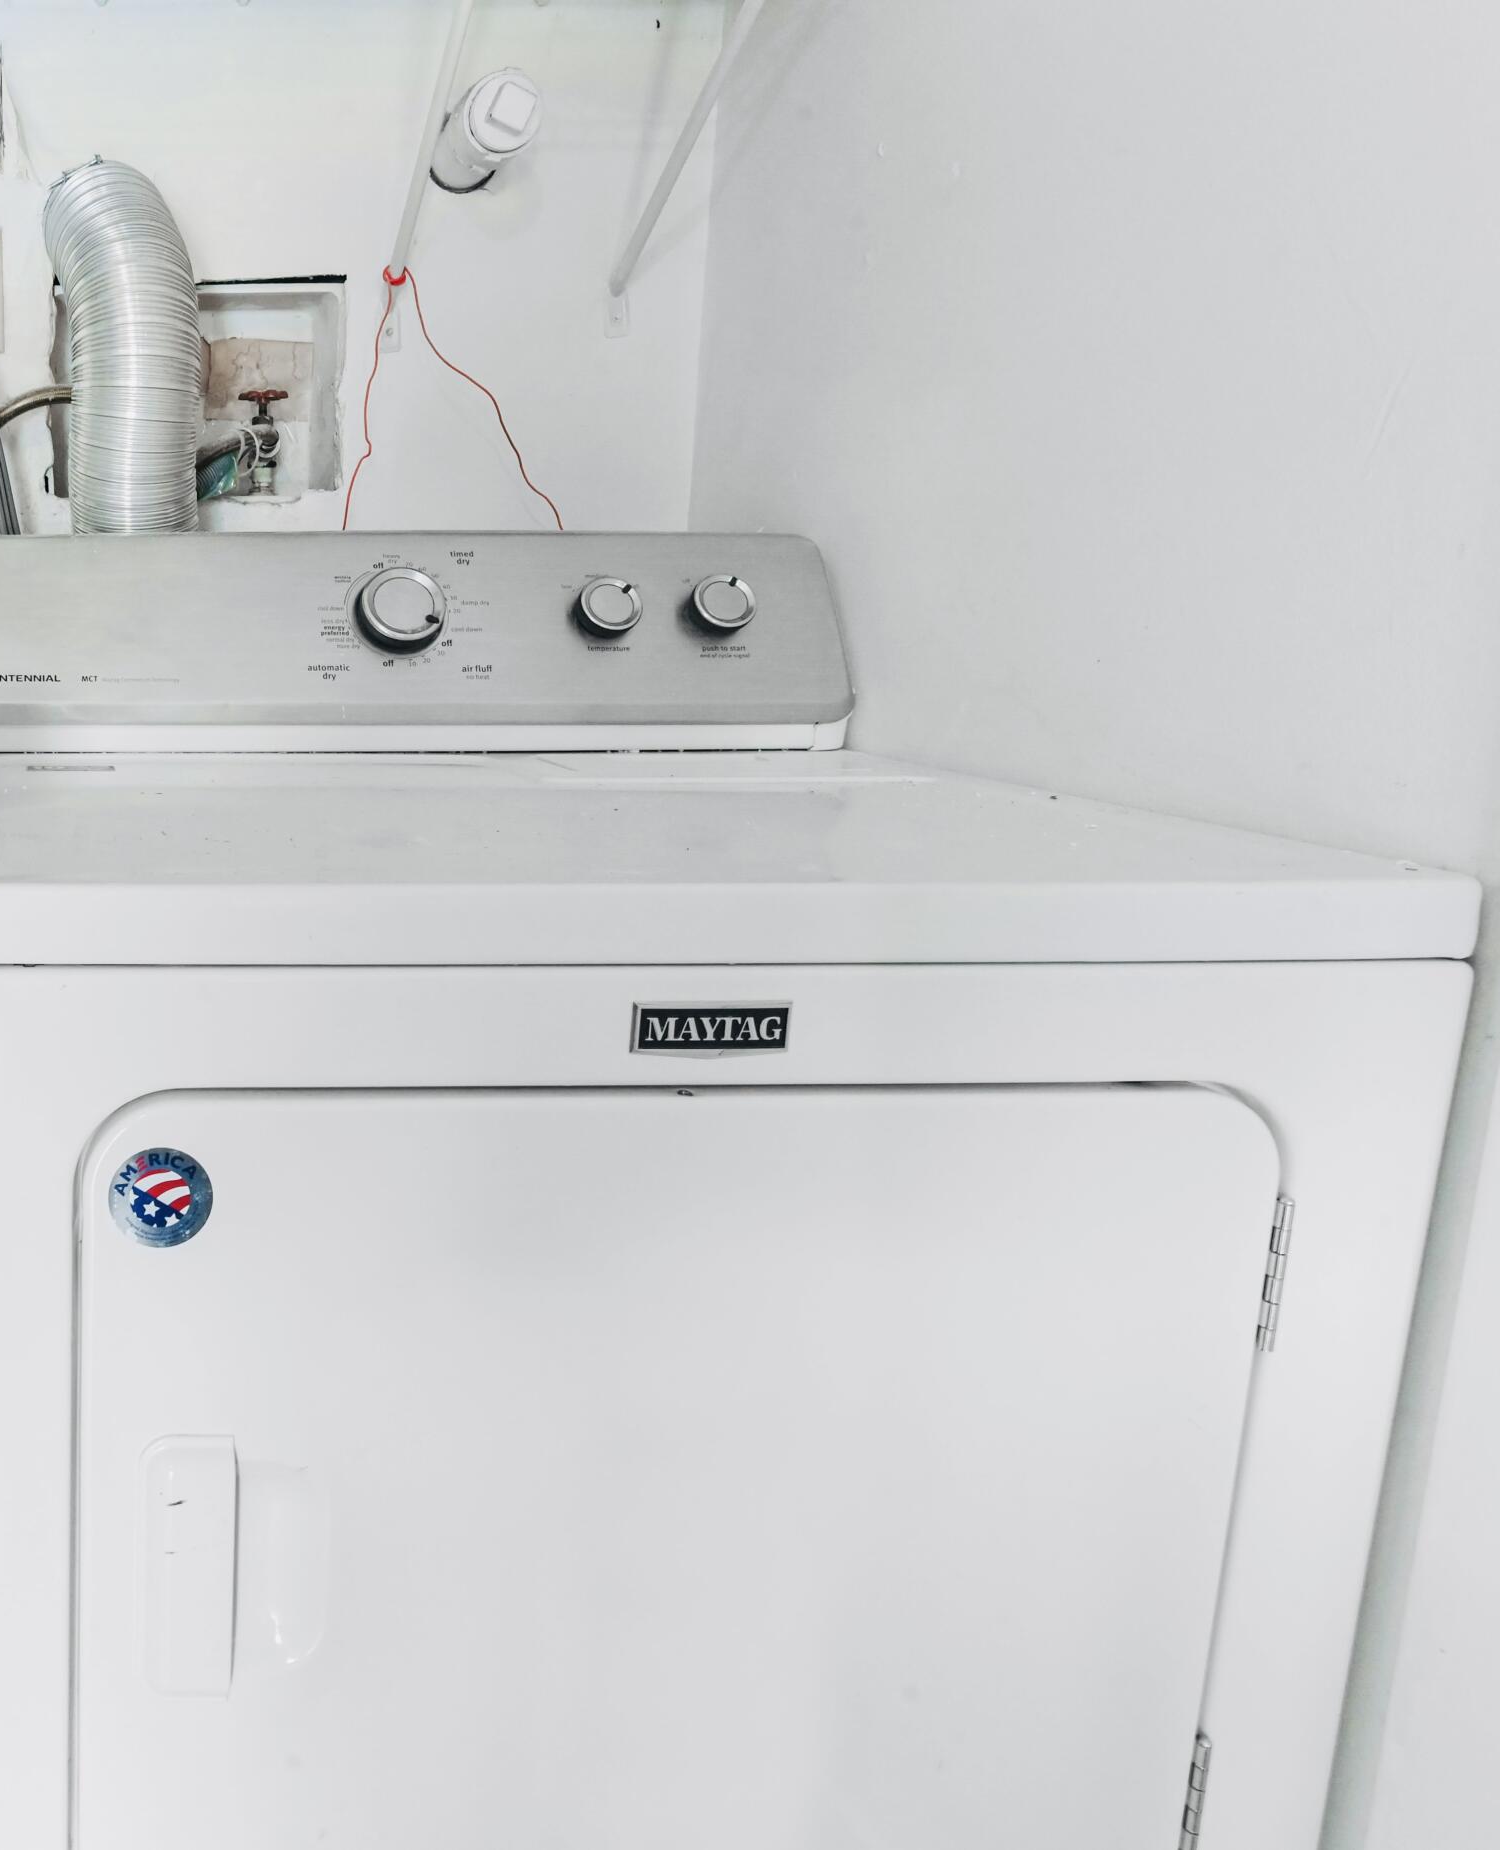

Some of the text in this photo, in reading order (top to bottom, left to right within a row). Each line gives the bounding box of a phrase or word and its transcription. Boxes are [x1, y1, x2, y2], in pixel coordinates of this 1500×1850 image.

[456, 558, 470, 566] dry
[441, 639, 453, 647] off
[587, 645, 631, 653] temperature
[702, 645, 719, 653] push
[307, 664, 350, 672] automatic
[383, 660, 394, 668] off
[462, 665, 493, 673] air fluff
[81, 675, 98, 683] MCT
[322, 672, 337, 681] dry
[645, 1016, 782, 1042] MAYTAG
[114, 1152, 197, 1196] AMERICA
